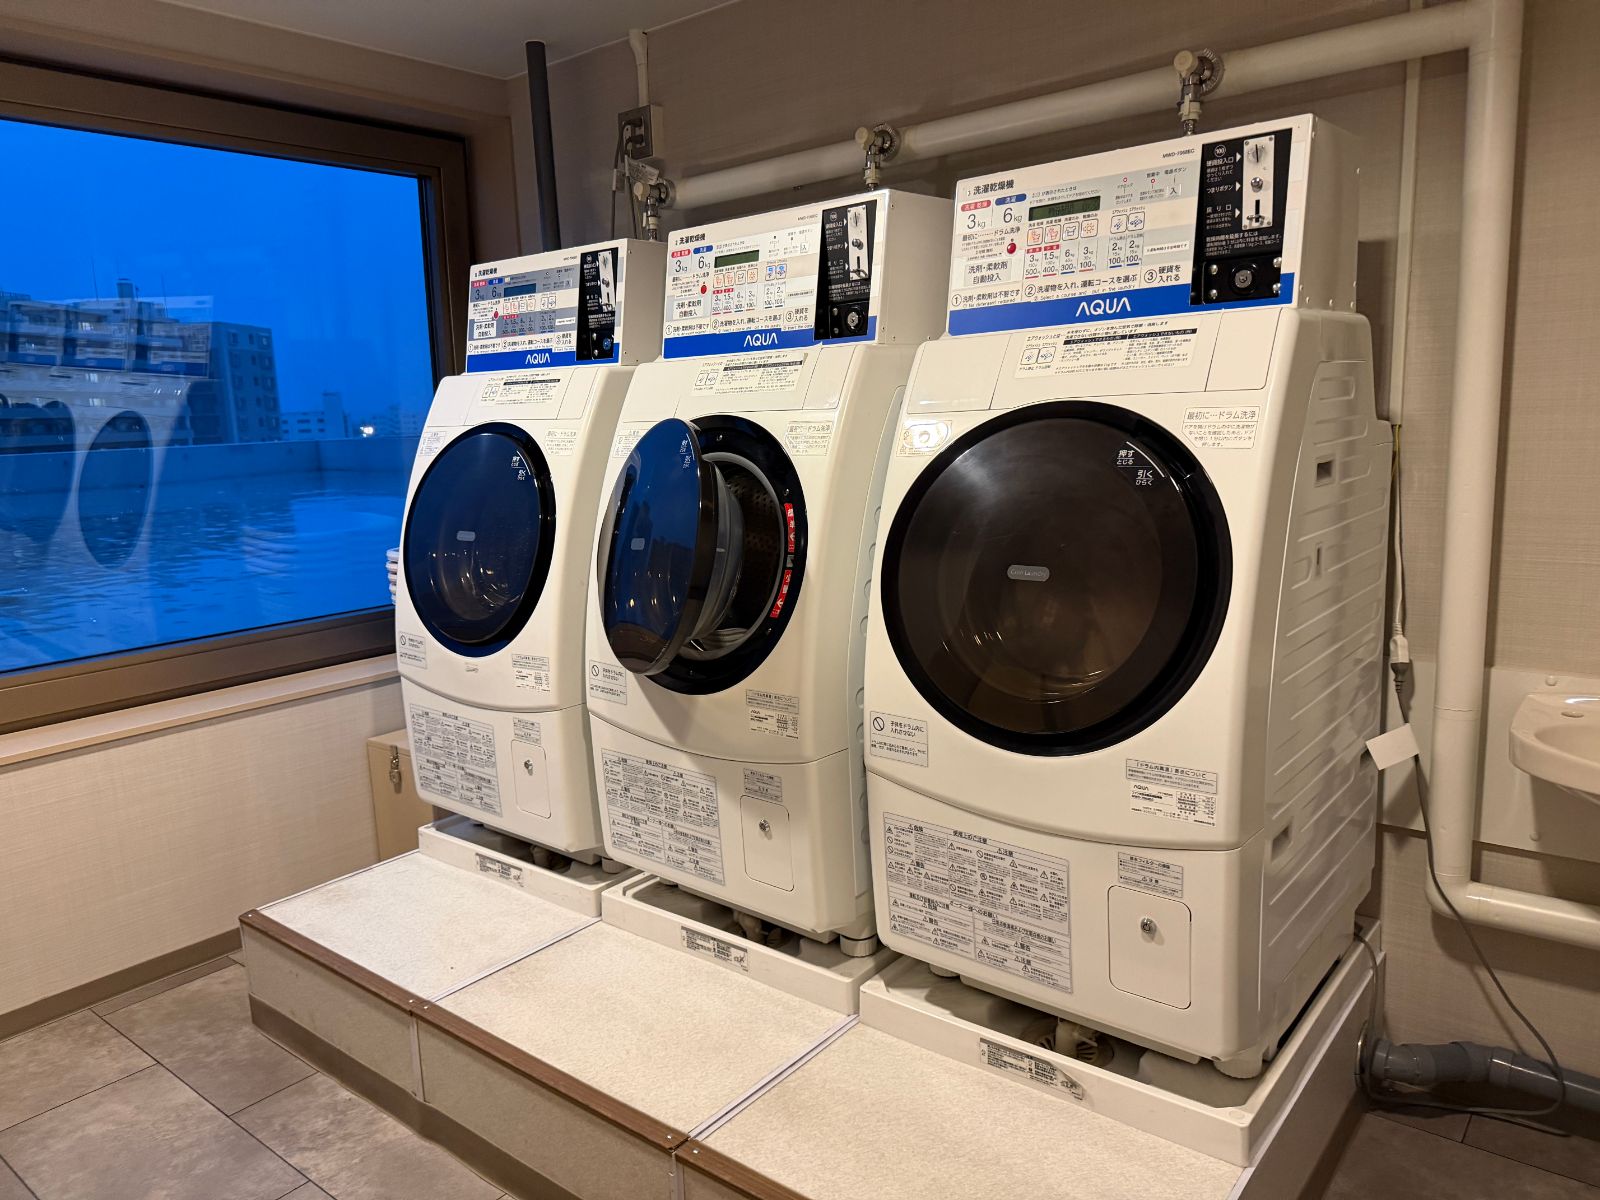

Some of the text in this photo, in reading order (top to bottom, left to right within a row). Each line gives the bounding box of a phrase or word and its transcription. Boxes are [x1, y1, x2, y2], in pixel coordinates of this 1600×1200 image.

[973, 179, 1014, 196] 洗濯乾燥機
[968, 260, 1008, 274] 洗剤・柔軟剤
[973, 273, 1002, 285] 自動投入
[1075, 297, 1132, 317] AQUA
[743, 332, 778, 348] AQUA
[525, 353, 551, 365] AQUA
[1118, 449, 1135, 458] 押す
[1137, 469, 1153, 479] 引く
